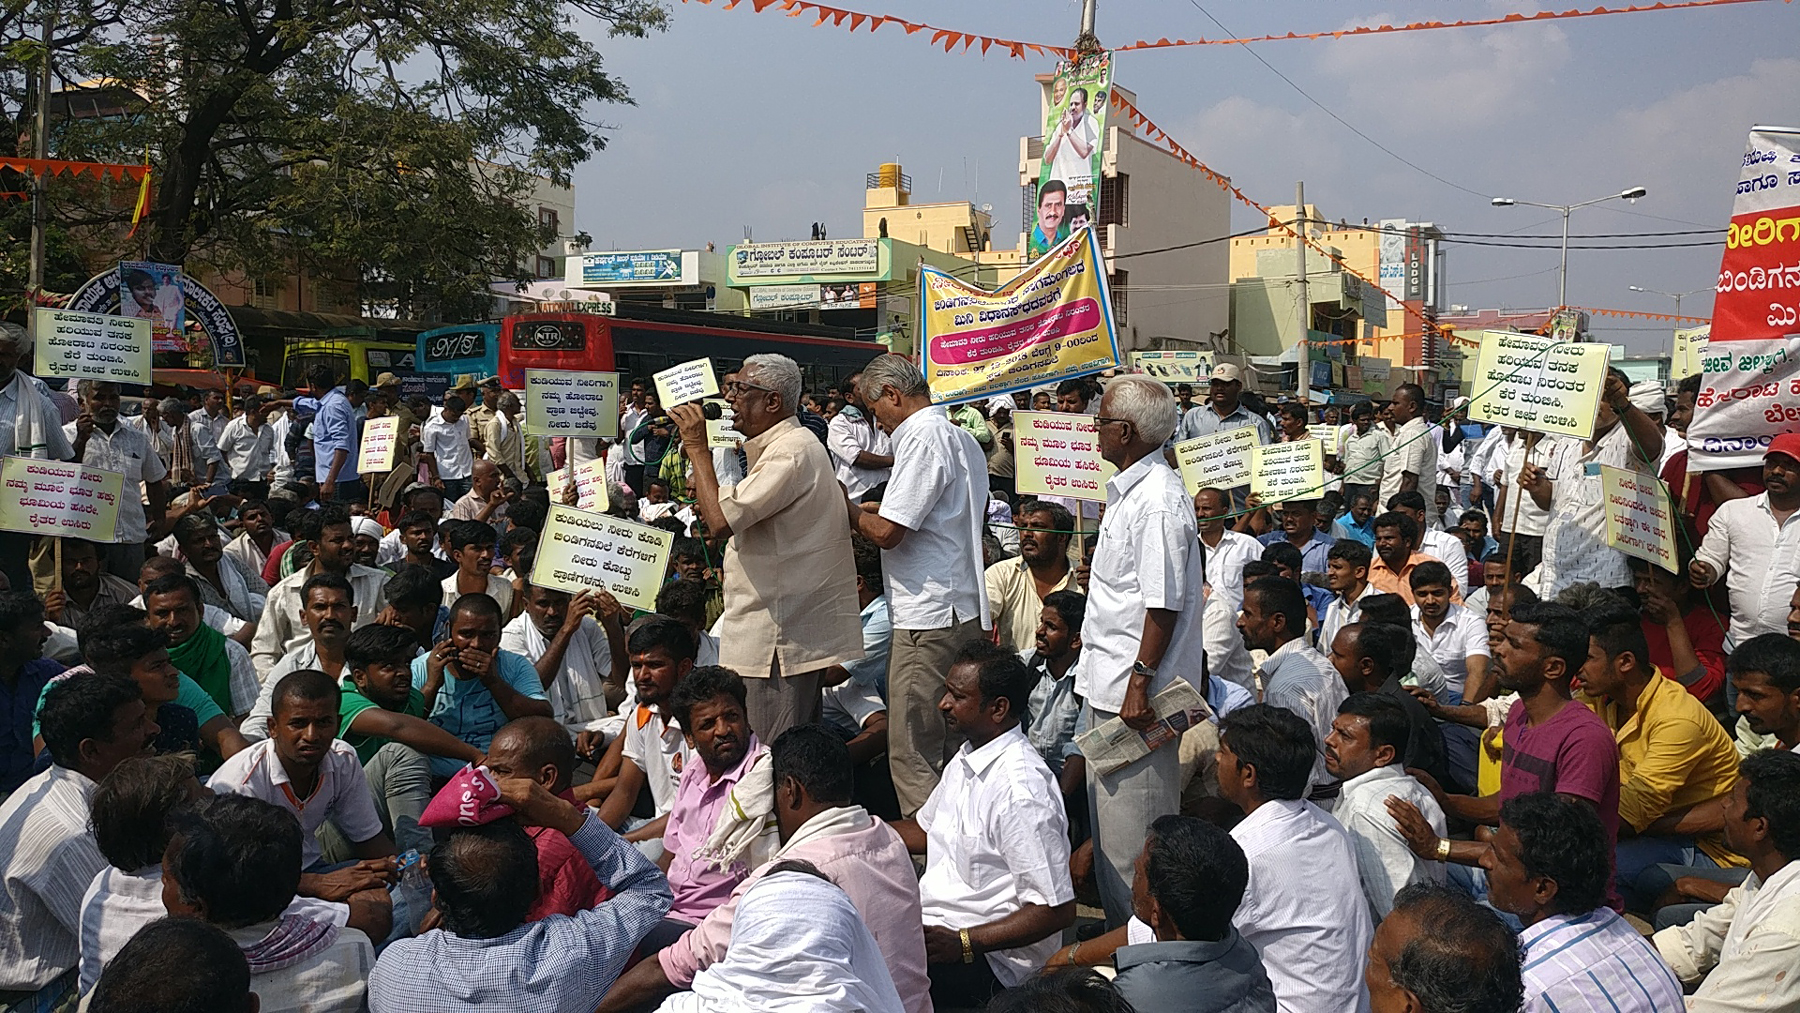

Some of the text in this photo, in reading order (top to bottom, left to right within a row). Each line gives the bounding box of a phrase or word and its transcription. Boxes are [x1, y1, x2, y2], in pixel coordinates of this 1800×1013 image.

[837, 243, 868, 258] ಸೆಂಟರ್
[1411, 253, 1419, 293] LODGE
[536, 302, 612, 313] NATIONAL EXPRESS
[54, 312, 135, 329] ಹೇಮಾವತಿ ನೀರು
[954, 313, 974, 326] ಮಿನಿ
[56, 325, 133, 340] ಹರಿಯುವ ತನಕ
[48, 336, 141, 353] ಹೋರಾಟ ನಿರಂತರ
[1498, 336, 1585, 356] ಹೇಮಾವತಿ ನೀರು
[64, 350, 81, 360] ಕೆರೆ
[1703, 351, 1733, 374] ಜೀವ
[49, 361, 140, 378] ರೈತರ ಜೀವ ಉಳಿಸಿ
[1497, 354, 1579, 374] ಹರಿಯುವ ತನಕ
[530, 376, 573, 386] ಕುಡಿಯುವ
[577, 378, 614, 388] ನೀರಿಗಾಗಿ
[1487, 369, 1586, 392] ಹೋರಾಟ ನಿರಂತರ
[541, 391, 603, 403] ನಮ್ಮ ಹೋರಾಟ
[1499, 388, 1516, 400] ಕೆರೆ
[546, 406, 566, 416] ಪ್ರಾಣ
[1482, 402, 1578, 428] ರೈತರ ಜೀವ ಉಳಿಸಿ
[548, 420, 571, 429] ನೀರು
[1033, 419, 1097, 433] ಕುಡಿಯುವ ನೀರು
[1020, 436, 1039, 452] ನಮ್ಮ
[1042, 436, 1067, 449] ಮೂಲ
[1070, 440, 1092, 452] ಭೂತ
[1180, 441, 1212, 453] ಕುಡಿಯಲು
[1215, 435, 1232, 445] ನೀರು
[1261, 443, 1312, 455] ಹೇಮಾವತಿ ನೀರು
[1034, 455, 1071, 468] ಭೂಮಿಯ
[1263, 452, 1310, 466] ಹರಿಯುವ ತನಕ
[27, 464, 103, 483] ಕುಡಿಯುವ ನೀರು
[1203, 464, 1220, 474] ನೀರು
[1258, 463, 1316, 477] ಹೋರಾಟ ನಿರಂತರ
[1045, 474, 1099, 490] ರೈತರ ಉಸಿರು
[1267, 477, 1278, 487] ಕೆರೆ
[6, 478, 116, 506] ನಮ್ಮ ಮೂಲ ಭೂತ ಹಕ್ಕು
[19, 496, 65, 509] ಭೂಮಿಯ
[29, 513, 91, 530] ರೈತರ ಉಸಿರು
[555, 513, 603, 531] ಕುಡಿಯಲು
[607, 524, 633, 539] ನೀರು
[554, 531, 658, 564] ಬಿಂಡಿಗನವಿಲೆ ಕೆರೆಗಳಿಗೆ
[571, 554, 632, 581] ನೀರು ಕೊಟ್ಟು
[553, 569, 640, 597] ಪ್ರಾಣಿಗಳನ್ನು ಉಳಿಸಿ
